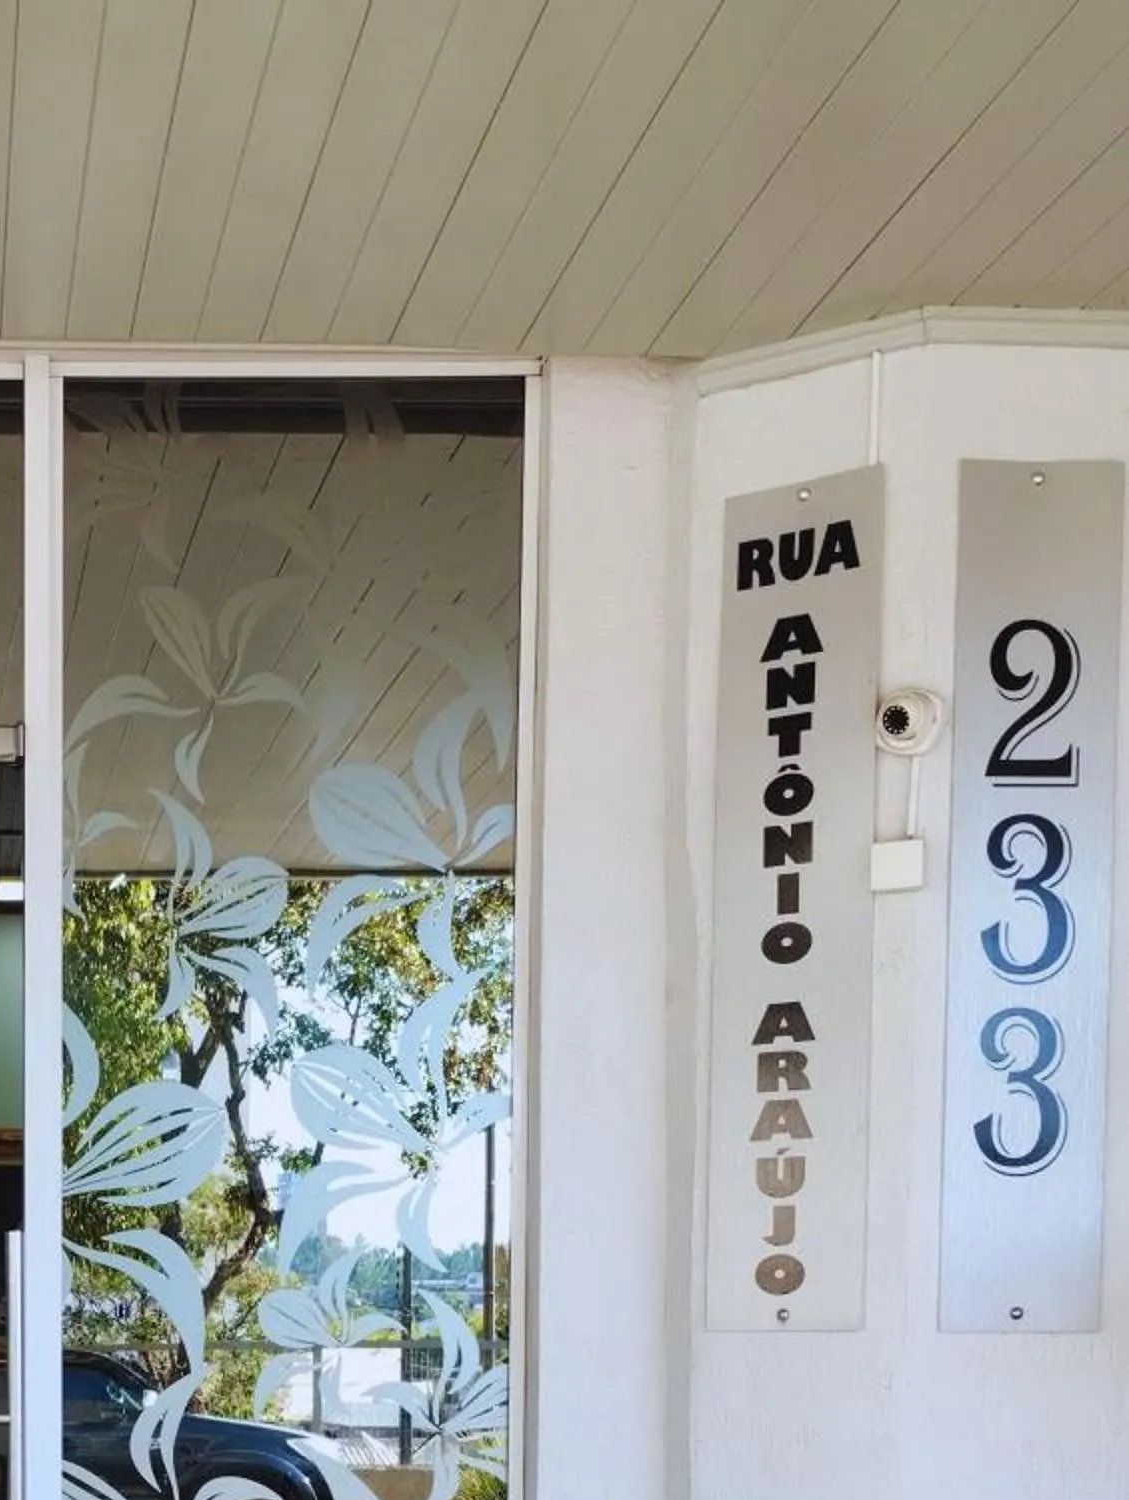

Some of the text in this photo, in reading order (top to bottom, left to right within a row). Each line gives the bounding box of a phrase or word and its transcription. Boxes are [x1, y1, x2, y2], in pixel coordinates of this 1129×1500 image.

[737, 519, 860, 591] RUA
[749, 613, 823, 1295] ANTÔNIO ARAÚJO
[973, 618, 1082, 1176] 233
